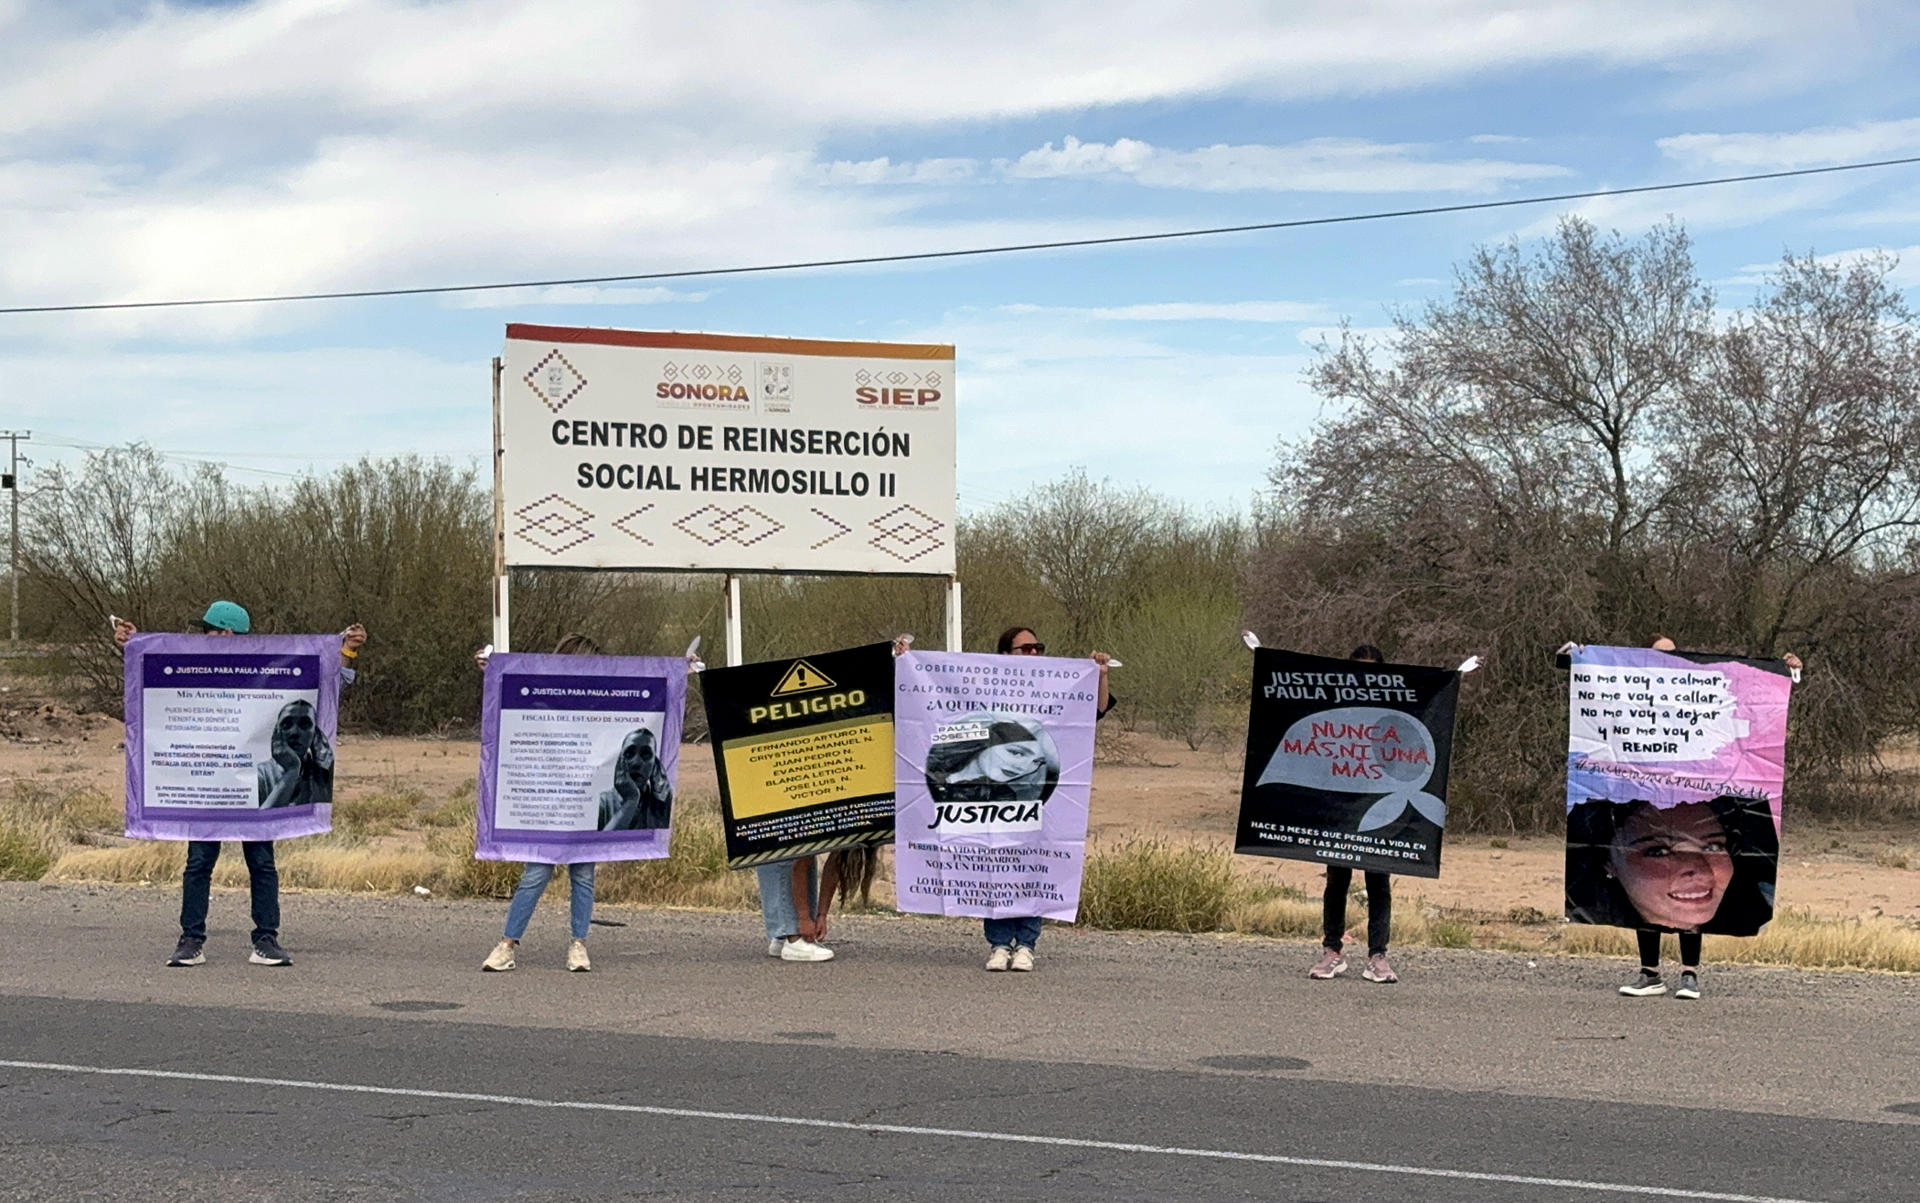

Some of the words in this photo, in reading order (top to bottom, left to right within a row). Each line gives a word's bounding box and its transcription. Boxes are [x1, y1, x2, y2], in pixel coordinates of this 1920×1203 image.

[657, 383, 749, 401] SONORA
[856, 387, 941, 405] SIEP
[552, 419, 667, 449] CENTRO
[678, 425, 713, 451] DE
[723, 426, 910, 457] REINSERCIÓN
[577, 462, 680, 491] SOCIAL
[691, 467, 869, 496] HERMOSILLO
[880, 473, 895, 497] II
[915, 664, 998, 675] GOBERNADOR
[1004, 668, 1025, 677] DEL
[1031, 669, 1080, 680] ESTADO
[1271, 671, 1359, 687] JUSTICIA
[1365, 674, 1406, 687] POR
[963, 676, 977, 685] DE
[984, 678, 1035, 687] SONORA
[1574, 674, 1591, 683] No
[1598, 674, 1617, 683] me
[1624, 676, 1650, 690] voy
[1671, 673, 1727, 688] calmar,
[177, 690, 193, 698] Mis
[238, 692, 284, 701] personales
[975, 687, 1025, 697] DURAZO
[1031, 690, 1094, 702] MONTAÑO
[1264, 686, 1327, 700] PAULA
[1335, 688, 1418, 703] JOSETTE
[1578, 691, 1595, 700] No
[1601, 692, 1620, 701] me
[1628, 693, 1654, 707] voy
[1675, 690, 1724, 705] callar,
[750, 690, 865, 724] PELIGRO
[927, 700, 943, 711] ¿A
[946, 700, 988, 712] QUIEN
[992, 703, 1064, 715] PROTEGE?
[1581, 708, 1598, 717] No
[1603, 710, 1622, 718] me
[1630, 711, 1656, 724] voy
[1662, 711, 1670, 719] a
[1676, 708, 1721, 725] dejar
[932, 730, 988, 741] JOSETTE
[939, 723, 980, 732] PAULA
[1311, 721, 1401, 743] NUNCA
[1598, 726, 1607, 740] y
[1613, 726, 1630, 735] No
[1636, 727, 1656, 735] me
[1663, 728, 1689, 742] voy
[751, 738, 810, 753] FERNANDO
[814, 729, 857, 742] ARTURO
[816, 738, 861, 750] MANUEL
[773, 757, 801, 768] JUAN
[805, 750, 840, 761] PEDRO
[1381, 747, 1431, 765] UNA
[773, 759, 843, 776] EVANGELINA
[766, 774, 810, 787] BLANCA
[813, 766, 852, 779] LETICIA
[784, 783, 810, 793] JOSE
[813, 778, 836, 787] LUIS
[790, 788, 831, 800] VICTOR
[749, 812, 812, 828] INCOMPETENCIA
[825, 805, 848, 815] ESTOS
[812, 815, 831, 823] VIDA
[844, 809, 858, 817] LAS
[928, 803, 1040, 829] JUSTICIA
[748, 830, 784, 842] INTERIOR
[795, 828, 825, 839] ESTADO
[1251, 821, 1276, 831] HACE
[1287, 826, 1319, 836] MESES
[1322, 831, 1342, 840] QUE
[1344, 834, 1373, 843] PERDI
[1389, 840, 1410, 849] VIDA
[1413, 843, 1427, 851] EN
[908, 842, 939, 851] PERDER
[940, 845, 951, 853] LA
[953, 846, 976, 855] VIDA
[978, 847, 996, 855] POR
[1039, 848, 1052, 857] DE
[1054, 850, 1071, 859] SUS
[1259, 832, 1293, 842] MANOS
[1298, 837, 1311, 845] DE
[1313, 840, 1331, 848] LAS
[1334, 843, 1400, 857] AUTORIDADES
[1402, 852, 1420, 861] DEL
[953, 854, 1021, 864] FUNCIONARIOS
[1316, 850, 1353, 861] CERESO
[955, 862, 970, 870] UN
[972, 863, 1010, 872] DELITO
[1012, 864, 1049, 874] MENOR
[917, 877, 929, 885] LO
[931, 878, 977, 888] HACEMOS
[979, 880, 1041, 890] RESPONSABLE
[1043, 883, 1057, 891] DE
[910, 886, 960, 896] CUALQUIER
[963, 888, 1011, 899] ATENTADO
[1021, 891, 1064, 901] NUESTRA
[957, 898, 1014, 908] INTEGRIDAD
